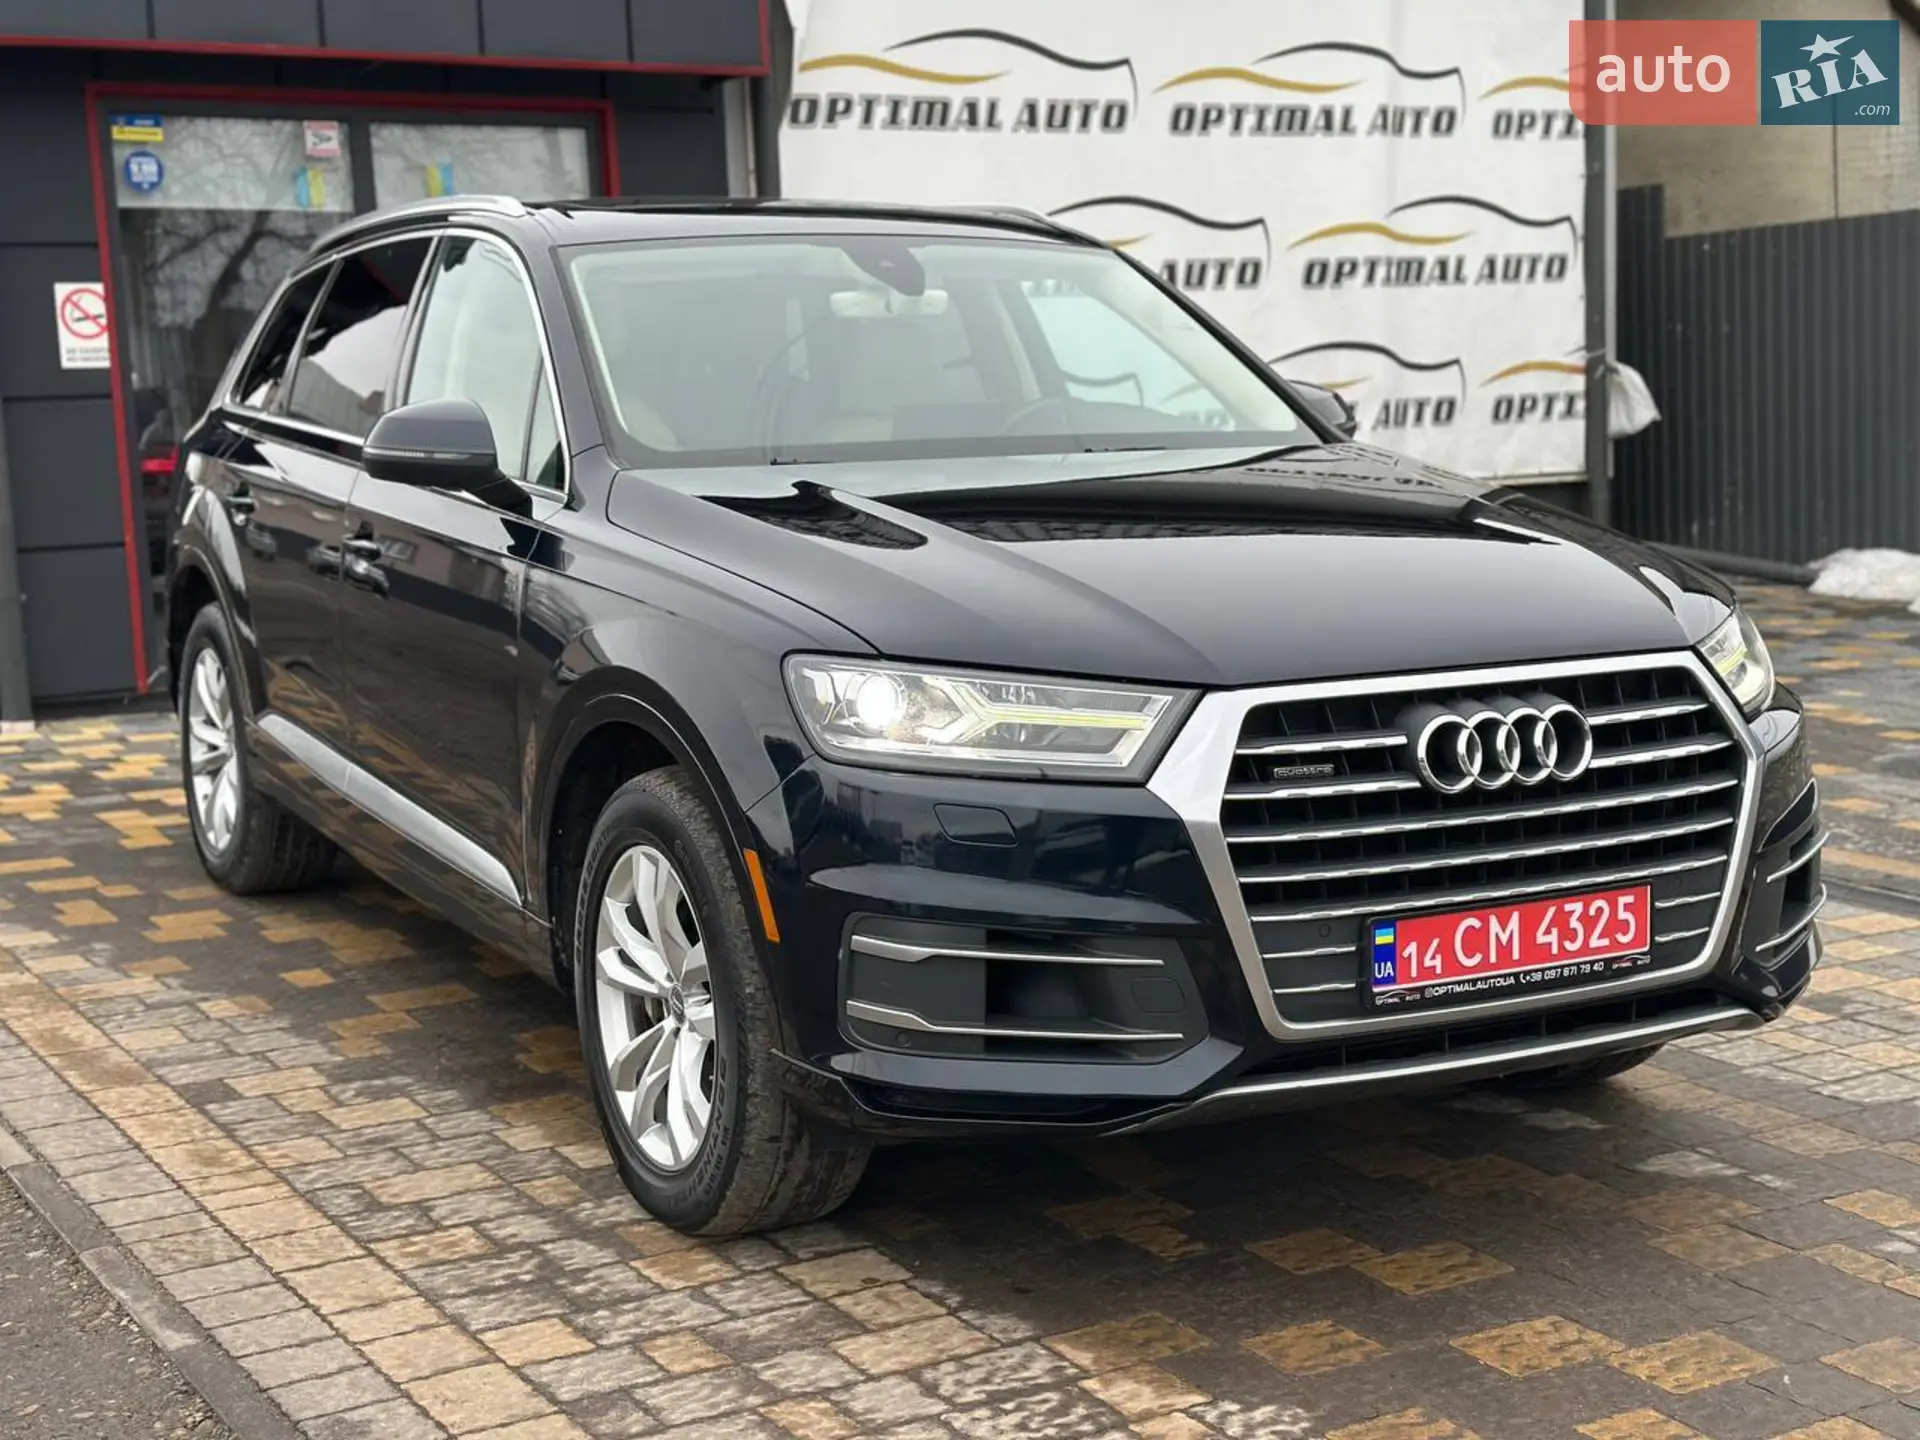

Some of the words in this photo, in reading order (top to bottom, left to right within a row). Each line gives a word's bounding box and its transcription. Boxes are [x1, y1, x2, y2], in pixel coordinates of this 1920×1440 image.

[786, 92, 1003, 134] OPTIMAL
[1011, 97, 1129, 134] AUTO
[1169, 102, 1357, 138] OPTIMAL
[1365, 103, 1458, 138] AUTO
[1159, 256, 1263, 292] AUTO
[1301, 254, 1467, 291] OPTIMAL
[1474, 252, 1569, 287] AUTO
[1371, 396, 1457, 431] AUTO
[1401, 937, 1443, 978] 14
[1454, 911, 1521, 968] CM
[1536, 894, 1637, 956] 4325
[1374, 961, 1395, 979] UA
[1544, 968, 1561, 980] 097
[1563, 965, 1578, 977] 871
[1580, 963, 1591, 974] 79
[1593, 961, 1605, 972] 40
